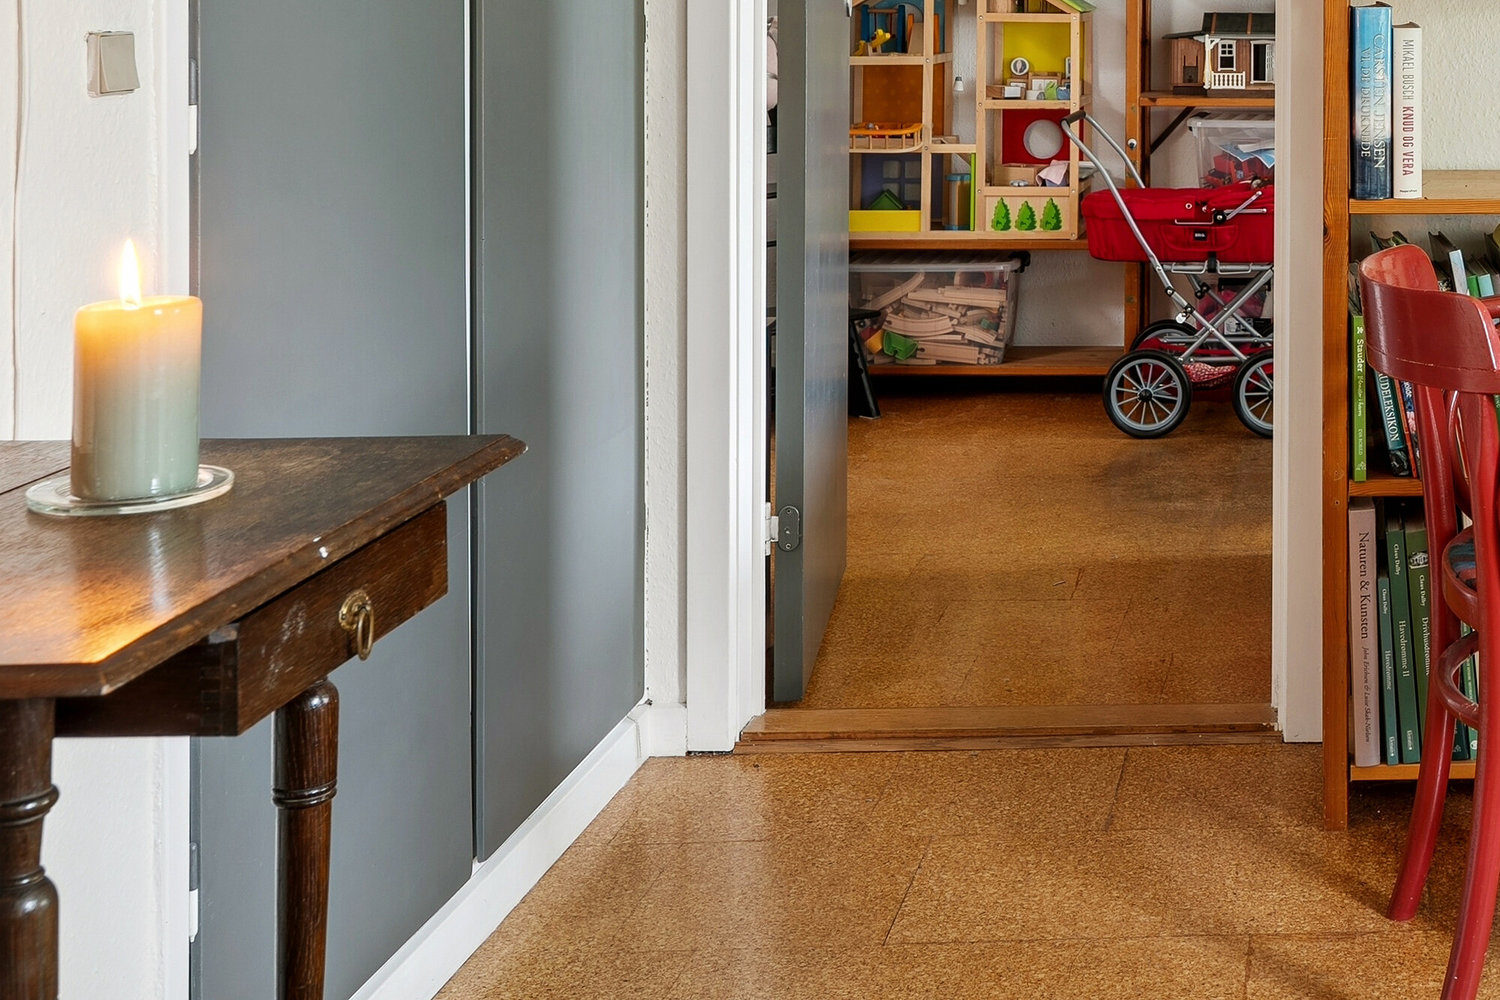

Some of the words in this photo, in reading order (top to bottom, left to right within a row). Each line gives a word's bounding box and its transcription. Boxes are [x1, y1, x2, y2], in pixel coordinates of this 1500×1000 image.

[1402, 39, 1415, 72] MIKAEL
[1402, 75, 1415, 101] BUSCH
[1402, 106, 1415, 132] KNUD
[1402, 134, 1415, 149] OG
[1402, 151, 1415, 176] VERA
[1356, 338, 1364, 373] Stauder
[1358, 531, 1370, 576] Naturen
[1360, 593, 1371, 640] Kunsten
